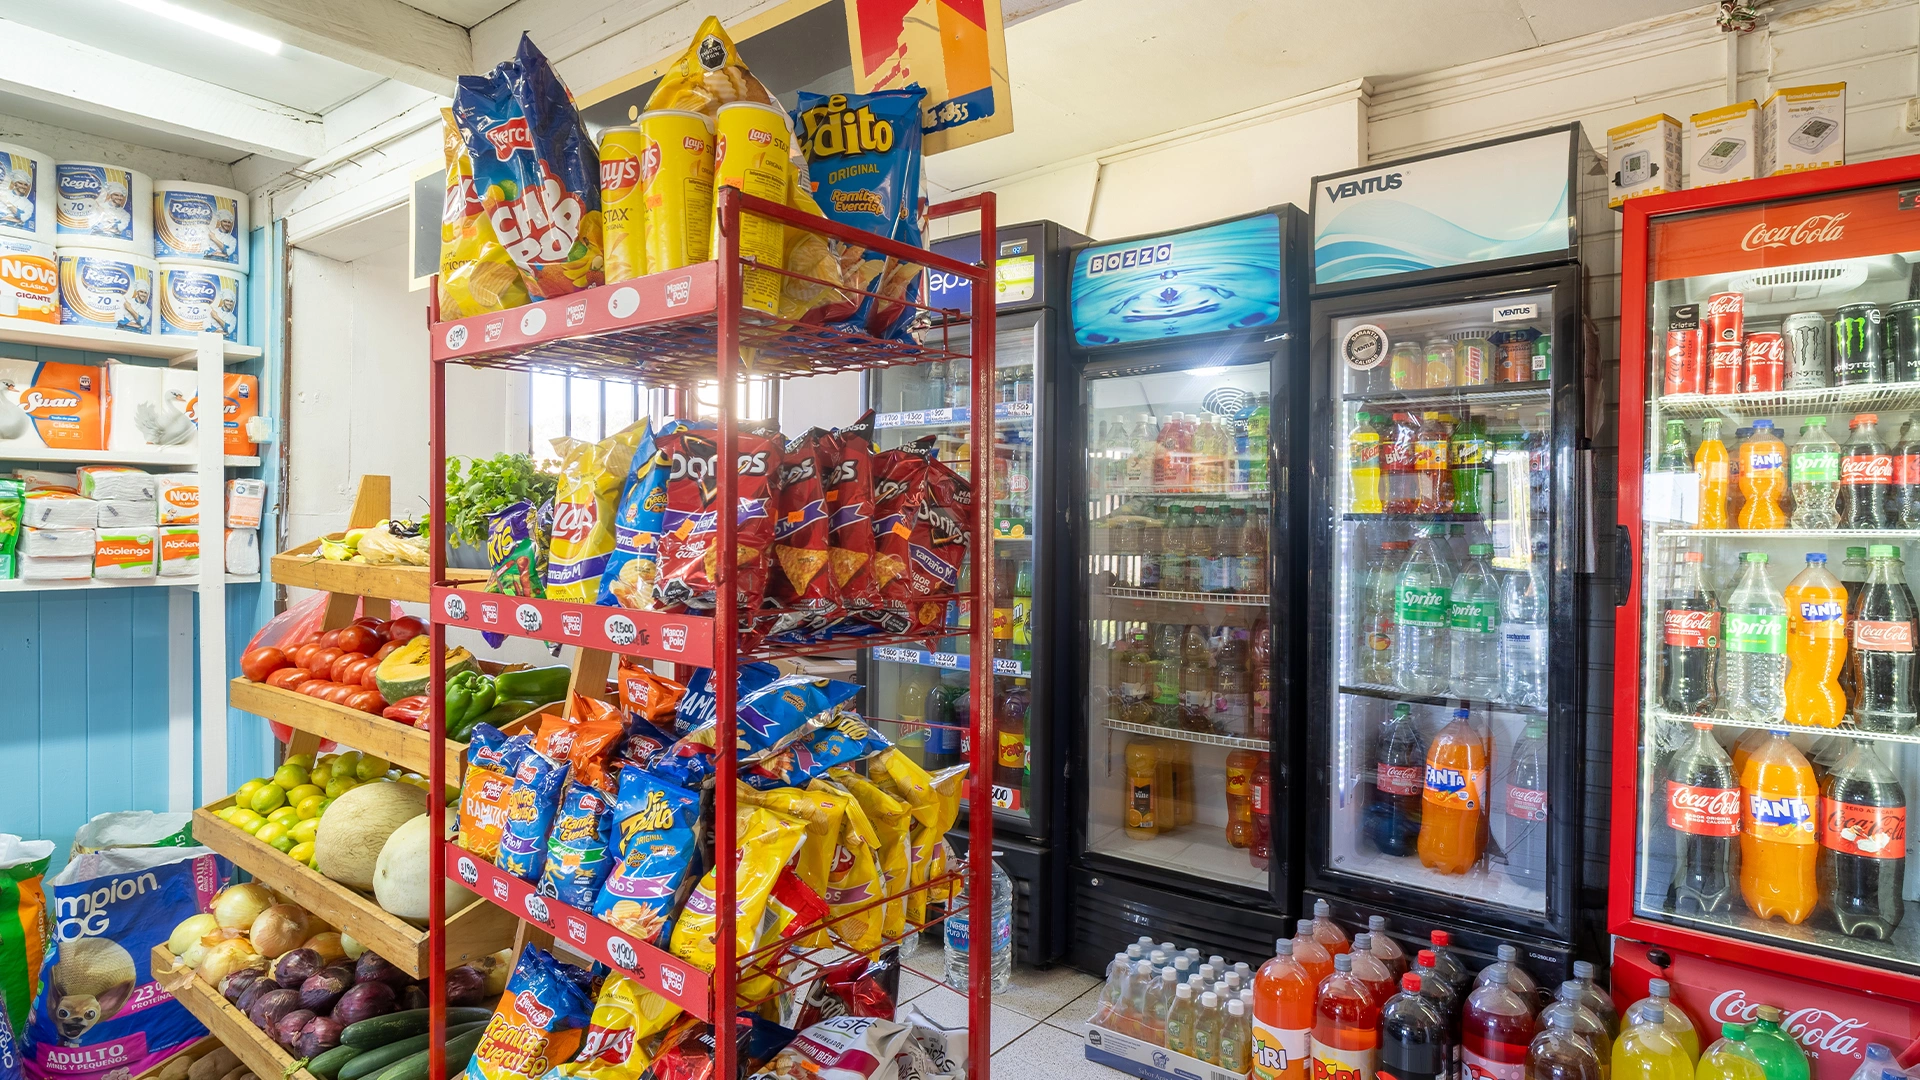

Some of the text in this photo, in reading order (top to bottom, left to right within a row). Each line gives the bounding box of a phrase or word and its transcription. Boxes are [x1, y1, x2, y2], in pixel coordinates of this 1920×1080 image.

[750, 128, 771, 144] Lay's
[685, 136, 704, 152] Lay's
[774, 138, 789, 153] STAX
[766, 160, 784, 172] ORIGINAL
[600, 158, 637, 190] ay's
[828, 164, 880, 185] ORIGINAL
[61, 177, 99, 190] Regio
[1325, 172, 1403, 204] VENTUS
[831, 189, 882, 203] Ramitas
[71, 202, 84, 210] 70
[172, 203, 210, 217] Regio
[834, 202, 885, 215] Evercrisp
[604, 208, 629, 224] STAX
[1741, 212, 1851, 252] Coca-Cola
[1091, 244, 1172, 274] BOZZO
[85, 270, 128, 286] Regio
[20, 282, 48, 292] CLÁSICA
[175, 277, 215, 295] Regio
[667, 282, 689, 295] Marco
[16, 292, 51, 303] GIGANTE
[98, 297, 111, 305] 70
[673, 290, 688, 301] Polo
[187, 306, 199, 315] 70
[567, 304, 585, 316] Marco
[613, 300, 618, 309] $
[572, 310, 584, 320] Polo
[1498, 307, 1531, 317] VENTUS
[1352, 329, 1379, 341] GARANTIA
[1354, 342, 1375, 353] VENTUS
[20, 392, 78, 413] Swan
[1751, 454, 1783, 469] FANTA
[1795, 456, 1839, 471] Sprite
[1842, 457, 1894, 477] Coca-Cola
[98, 546, 150, 557] Abolengo
[680, 541, 705, 550] SABOR
[916, 550, 953, 579] tamaño M
[548, 564, 581, 580] amaño M
[912, 572, 931, 586] ABOR
[1403, 591, 1443, 607] Sprite
[482, 604, 497, 613] Marco
[1452, 604, 1482, 617] Sprite
[1801, 602, 1842, 620] FANTA
[487, 612, 497, 620] Polo
[563, 614, 580, 624] Marco
[1664, 610, 1714, 630] Coca-Cola
[568, 622, 580, 631] Polo
[663, 627, 685, 639] Marco
[1730, 619, 1782, 637] Sprite
[1859, 624, 1909, 644] Coca-Cola
[669, 636, 684, 647] Polo
[628, 681, 649, 694] Marco
[635, 690, 648, 703] Polo
[632, 737, 654, 750] Marco
[634, 748, 650, 759] Polo
[1387, 766, 1416, 779] Coca-Cola
[1426, 764, 1465, 787] FANTA
[487, 789, 500, 798] Polo
[1510, 788, 1543, 804] Coca-Cola
[1672, 787, 1741, 815] Coca-Cola
[1750, 796, 1810, 818] FANTA
[467, 798, 508, 829] RAMITAS
[493, 878, 507, 890] Marco
[626, 882, 635, 893] S
[56, 872, 158, 917] mpion
[497, 886, 507, 897] Polo
[57, 912, 109, 943] OG
[568, 918, 585, 932] Marco
[573, 929, 586, 941] Polo
[947, 927, 961, 938] Pura
[662, 966, 685, 981] Marco
[667, 976, 684, 991] Polo
[131, 990, 173, 1010] PROTEÍNA
[517, 993, 554, 1027] Evercrisp
[1710, 990, 1869, 1056] Coc-Cola
[488, 1016, 549, 1055] Ramitas
[812, 1032, 845, 1050] HORNEADOS
[47, 1044, 125, 1064] ADULTO
[478, 1036, 549, 1079] Evercrisp
[46, 1054, 128, 1071] MINIS Y PEQUEÑOS
[1138, 1067, 1155, 1079] Sabor
